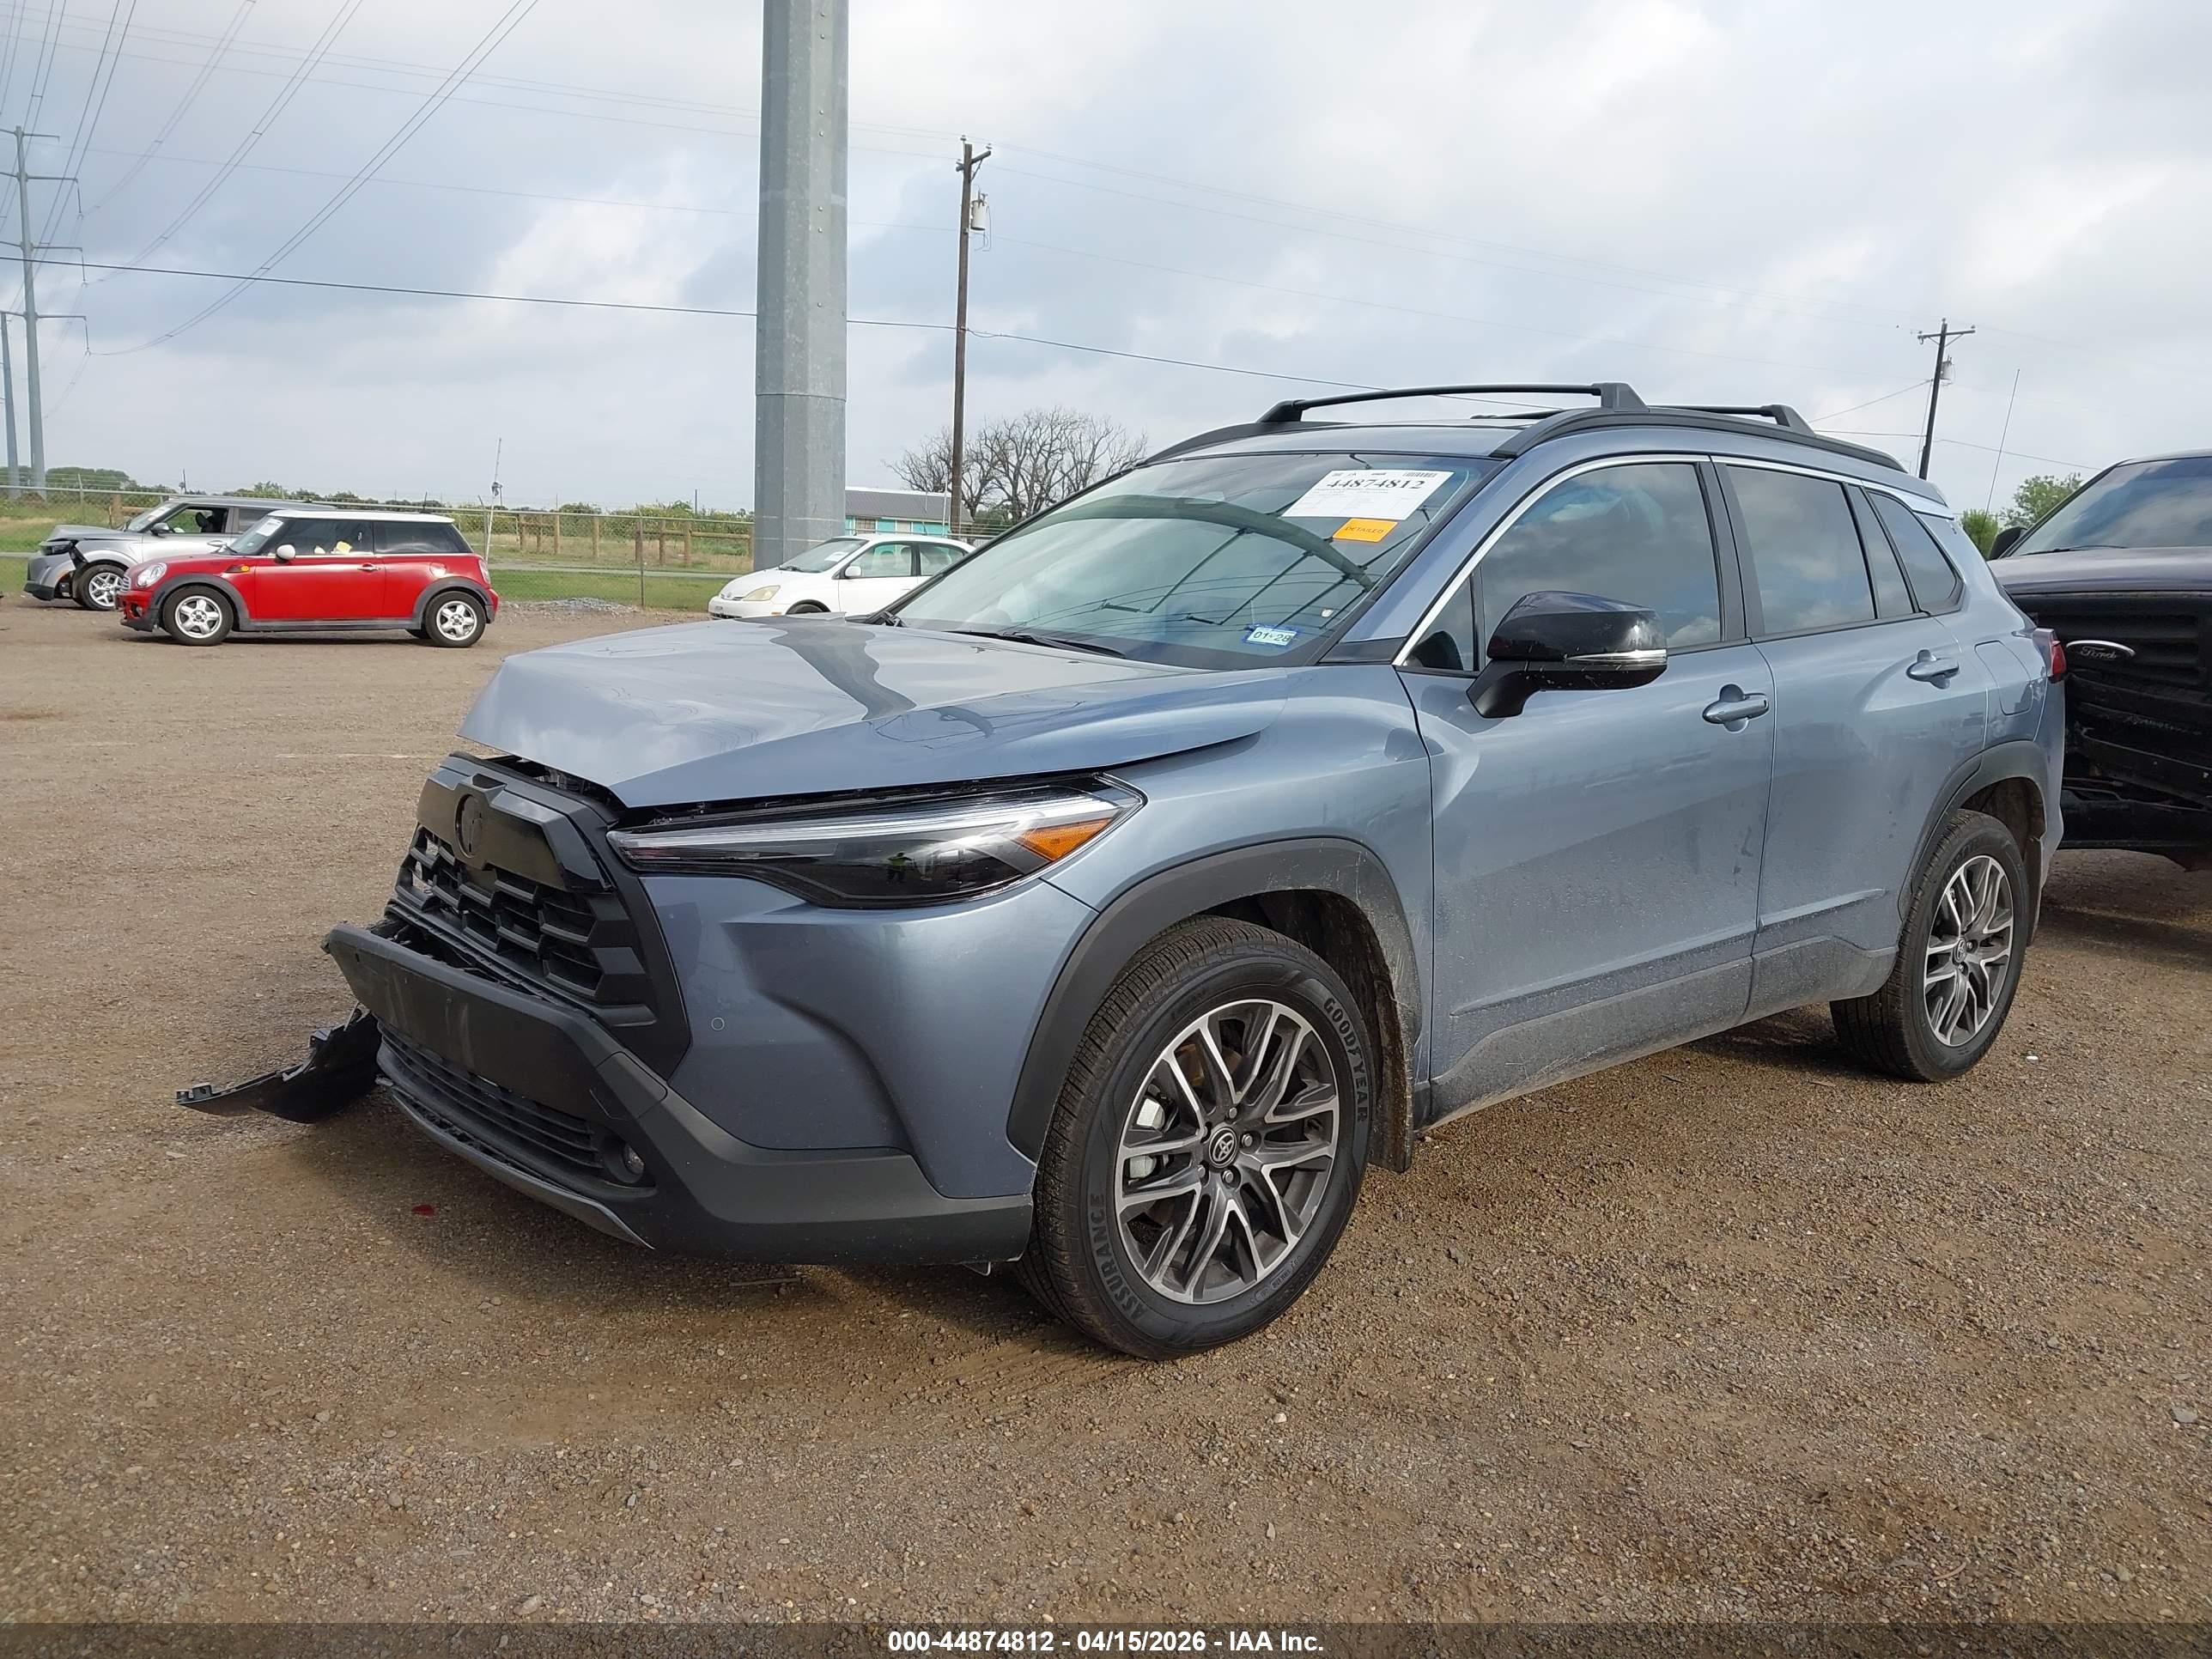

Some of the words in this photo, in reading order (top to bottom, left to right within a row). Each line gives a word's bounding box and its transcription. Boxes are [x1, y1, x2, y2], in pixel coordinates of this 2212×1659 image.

[1327, 478, 1425, 489] 44874812
[2080, 646, 2118, 659] Ford
[1323, 998, 1368, 1122] GOODYEAR
[1090, 1193, 1147, 1321] ASSURANCE
